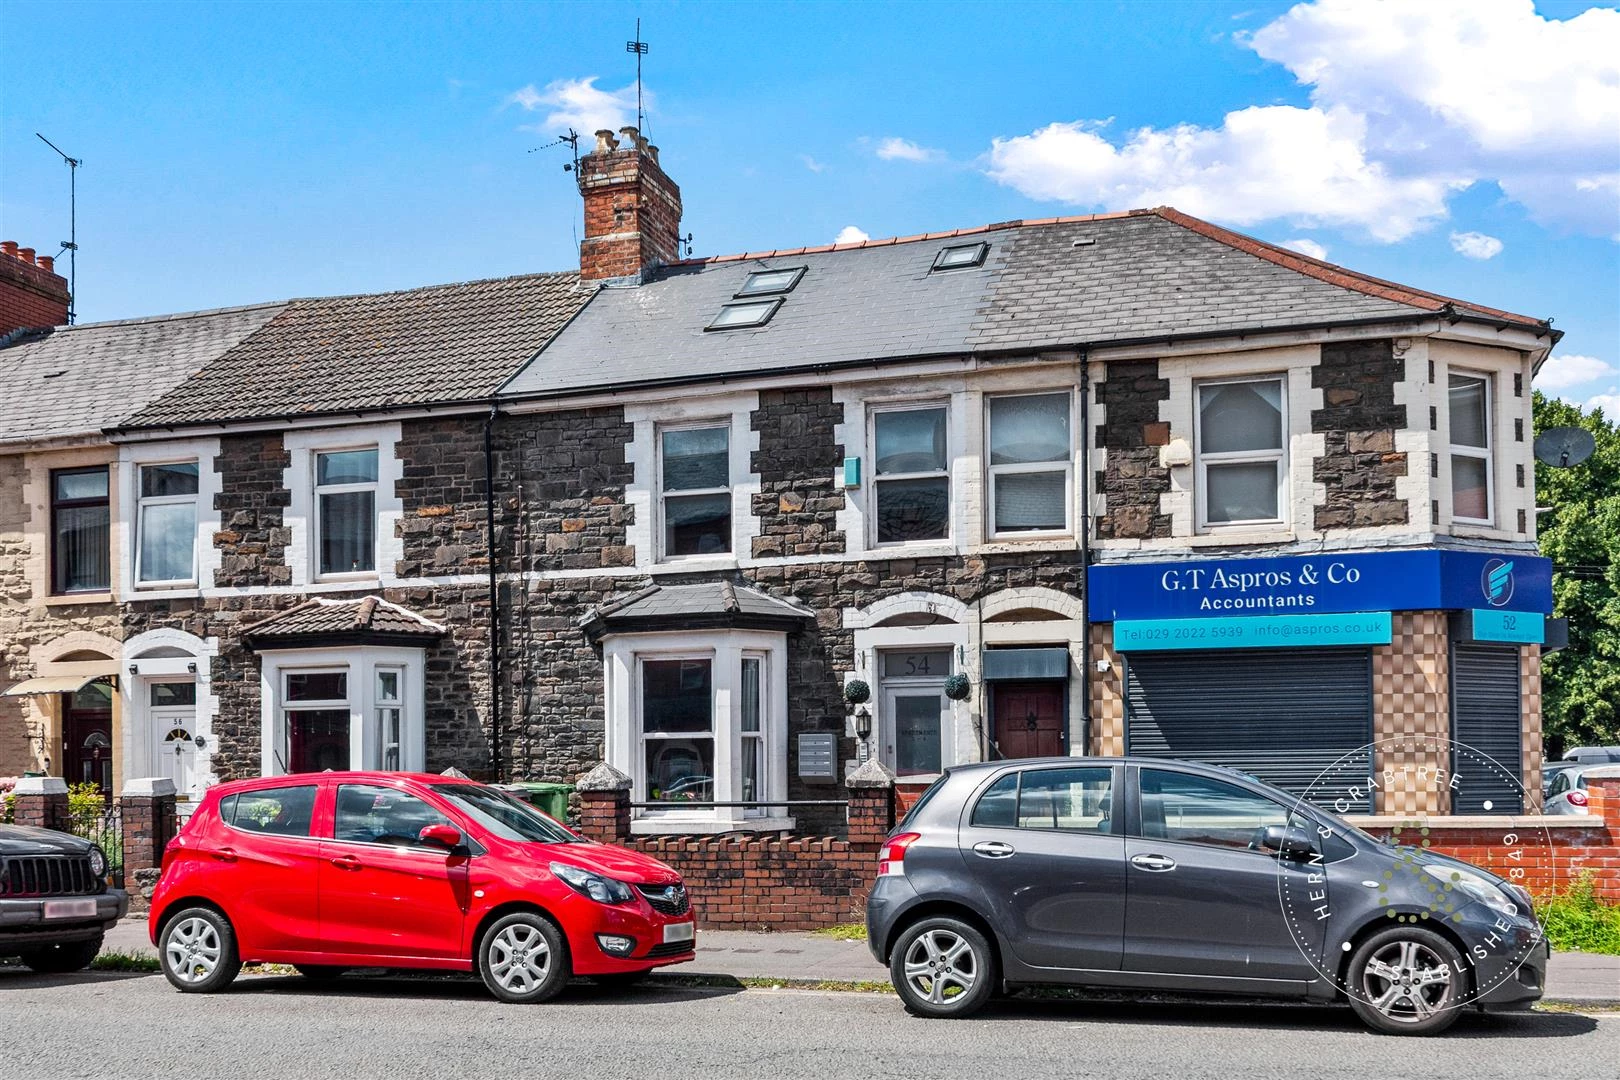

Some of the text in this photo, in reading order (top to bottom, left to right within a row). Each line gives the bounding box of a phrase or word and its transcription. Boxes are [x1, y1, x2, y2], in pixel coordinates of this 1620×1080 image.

[1161, 562, 1360, 592] G.T Aspros & Co
[1200, 594, 1315, 610] Accountants
[1254, 622, 1382, 638] info@aspros.co.uk
[1503, 615, 1516, 631] 52
[1123, 626, 1243, 640] Tel:029 2022 5939
[905, 655, 931, 675] 54
